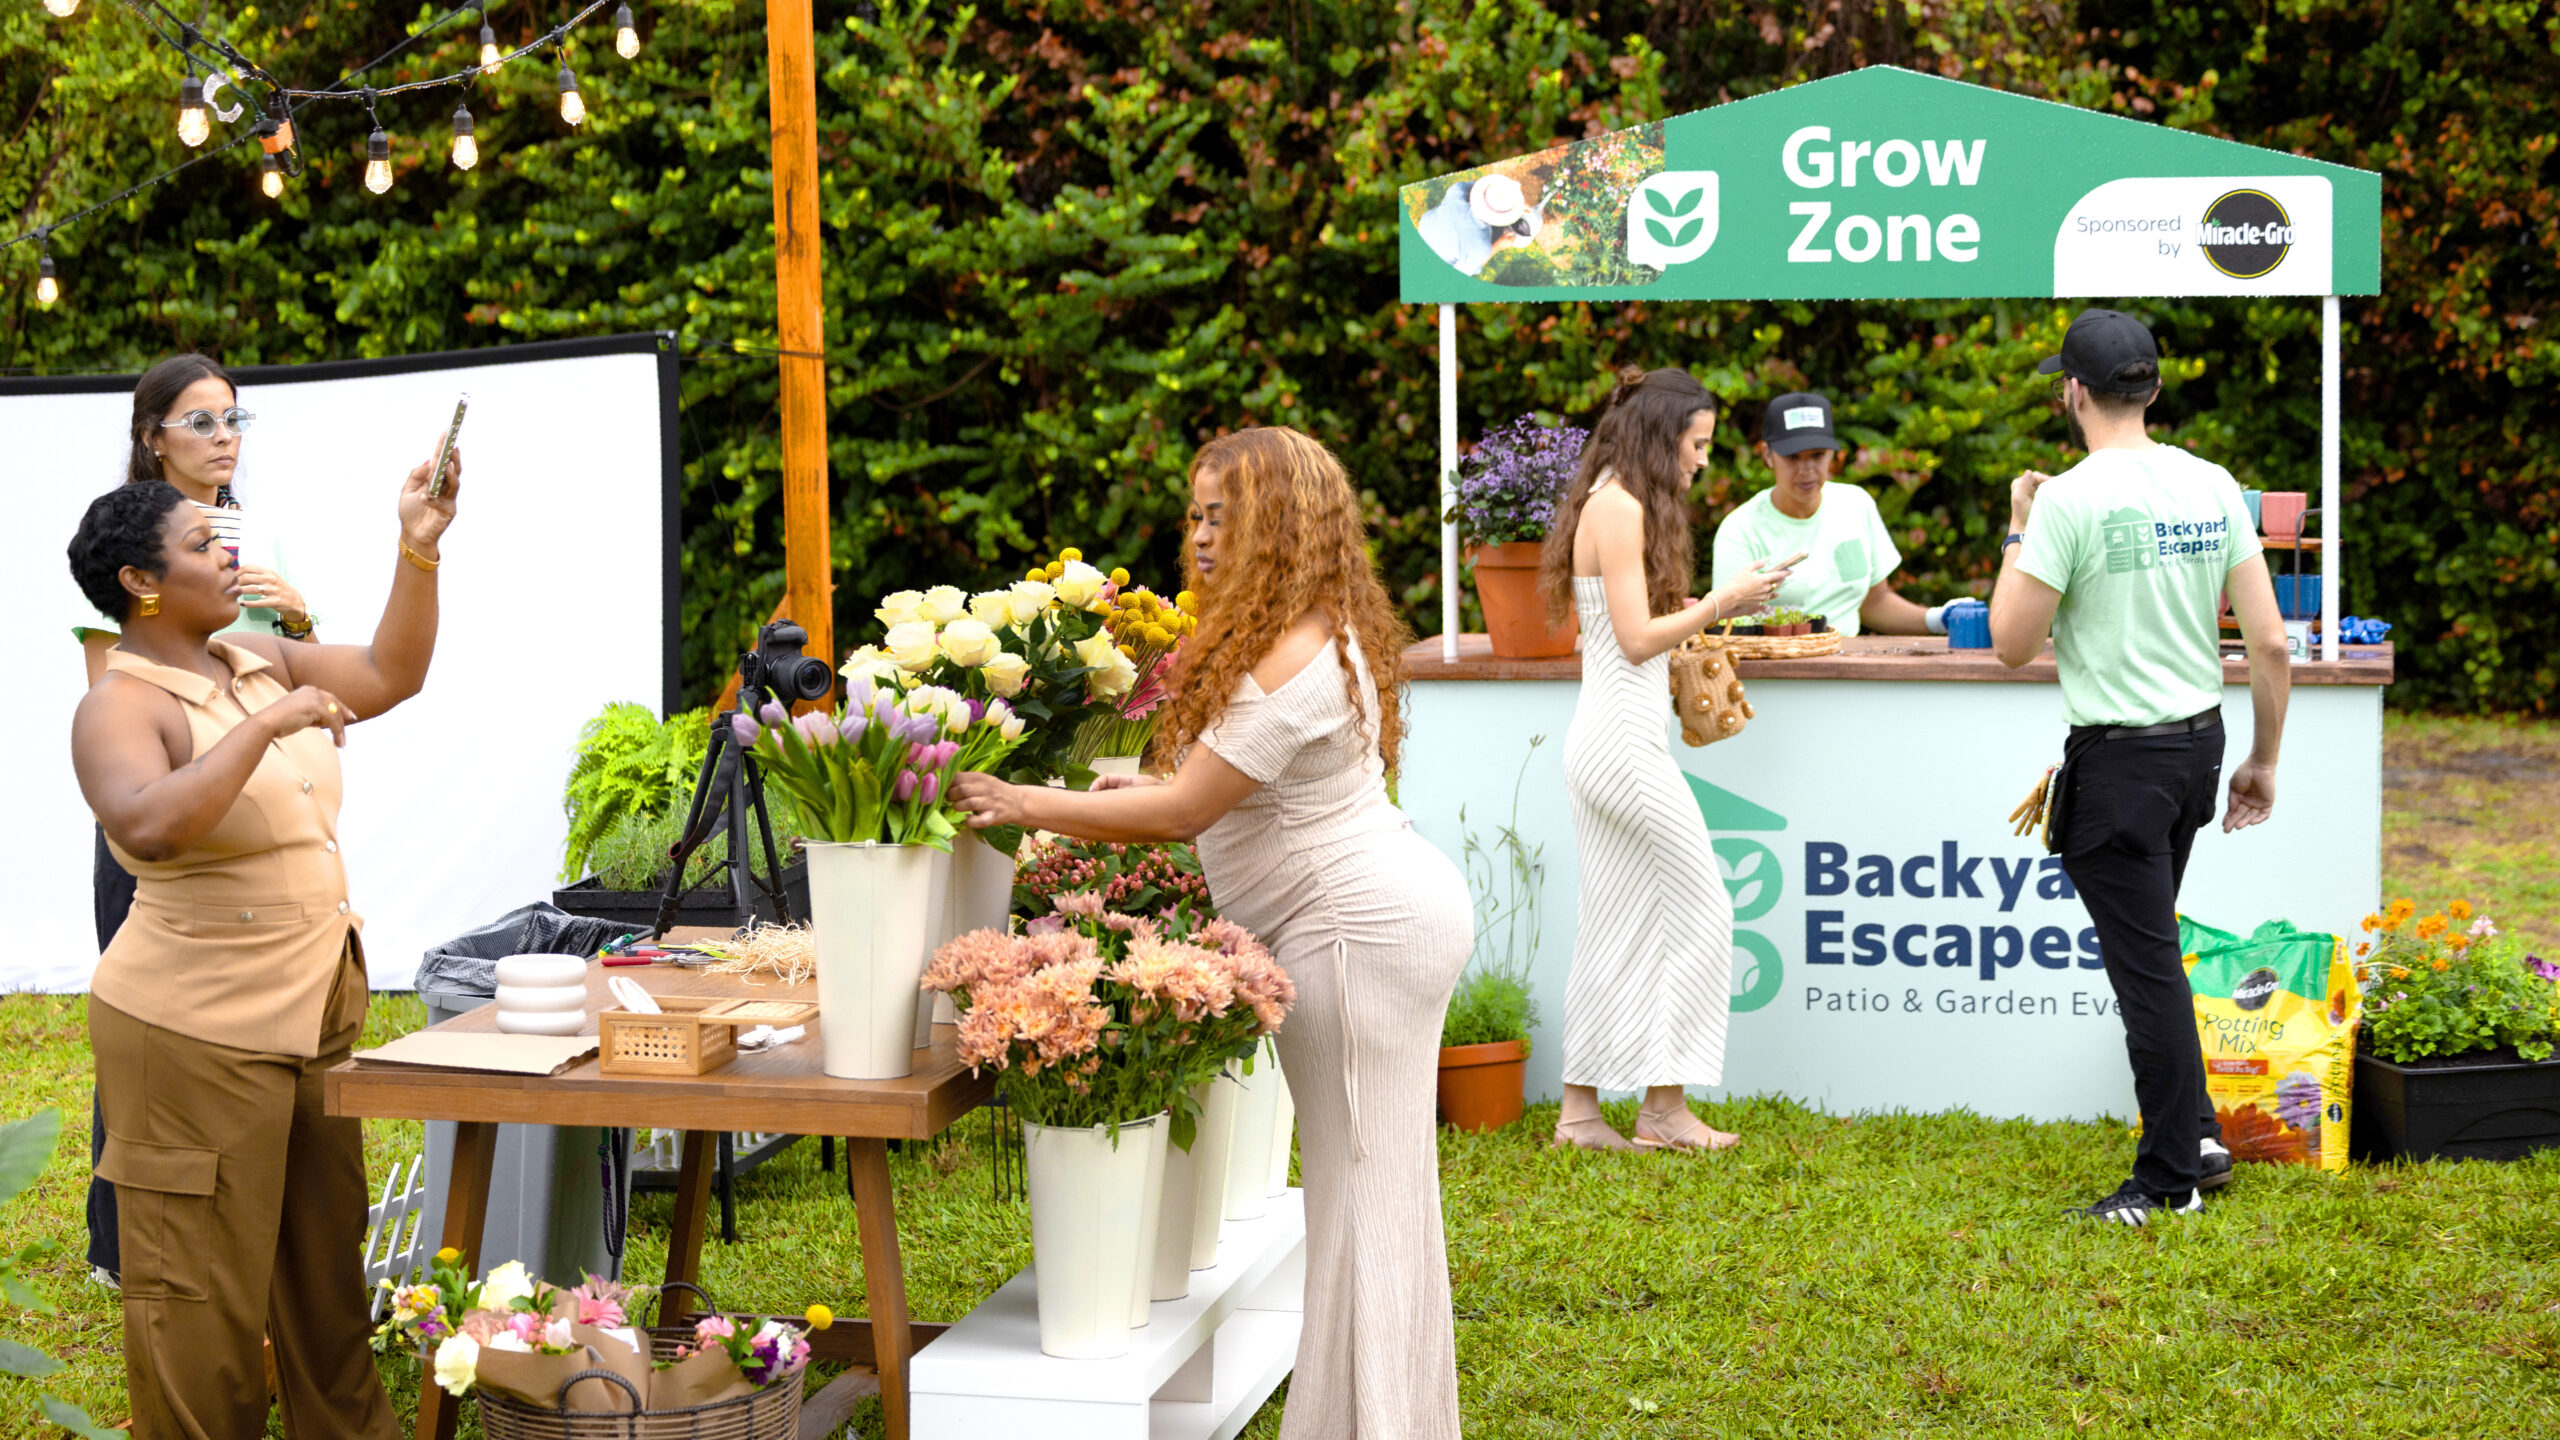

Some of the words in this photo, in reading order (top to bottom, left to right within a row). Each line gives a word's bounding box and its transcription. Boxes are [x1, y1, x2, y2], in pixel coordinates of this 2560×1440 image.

[1782, 125, 1987, 189] Grow
[1787, 201, 1981, 263] Zone
[2077, 215, 2181, 235] Sponsored
[2196, 221, 2296, 247] Miracle-Gro
[2158, 239, 2182, 258] by
[1805, 840, 2076, 913] Backya
[1805, 910, 2106, 981] Escapes
[1805, 987, 1890, 1012] Patio
[1903, 988, 1923, 1013] &
[1936, 989, 2057, 1015] Garden
[2073, 991, 2123, 1016] Eve
[2204, 1012, 2285, 1041] Potting
[2219, 1033, 2257, 1054] Mix
